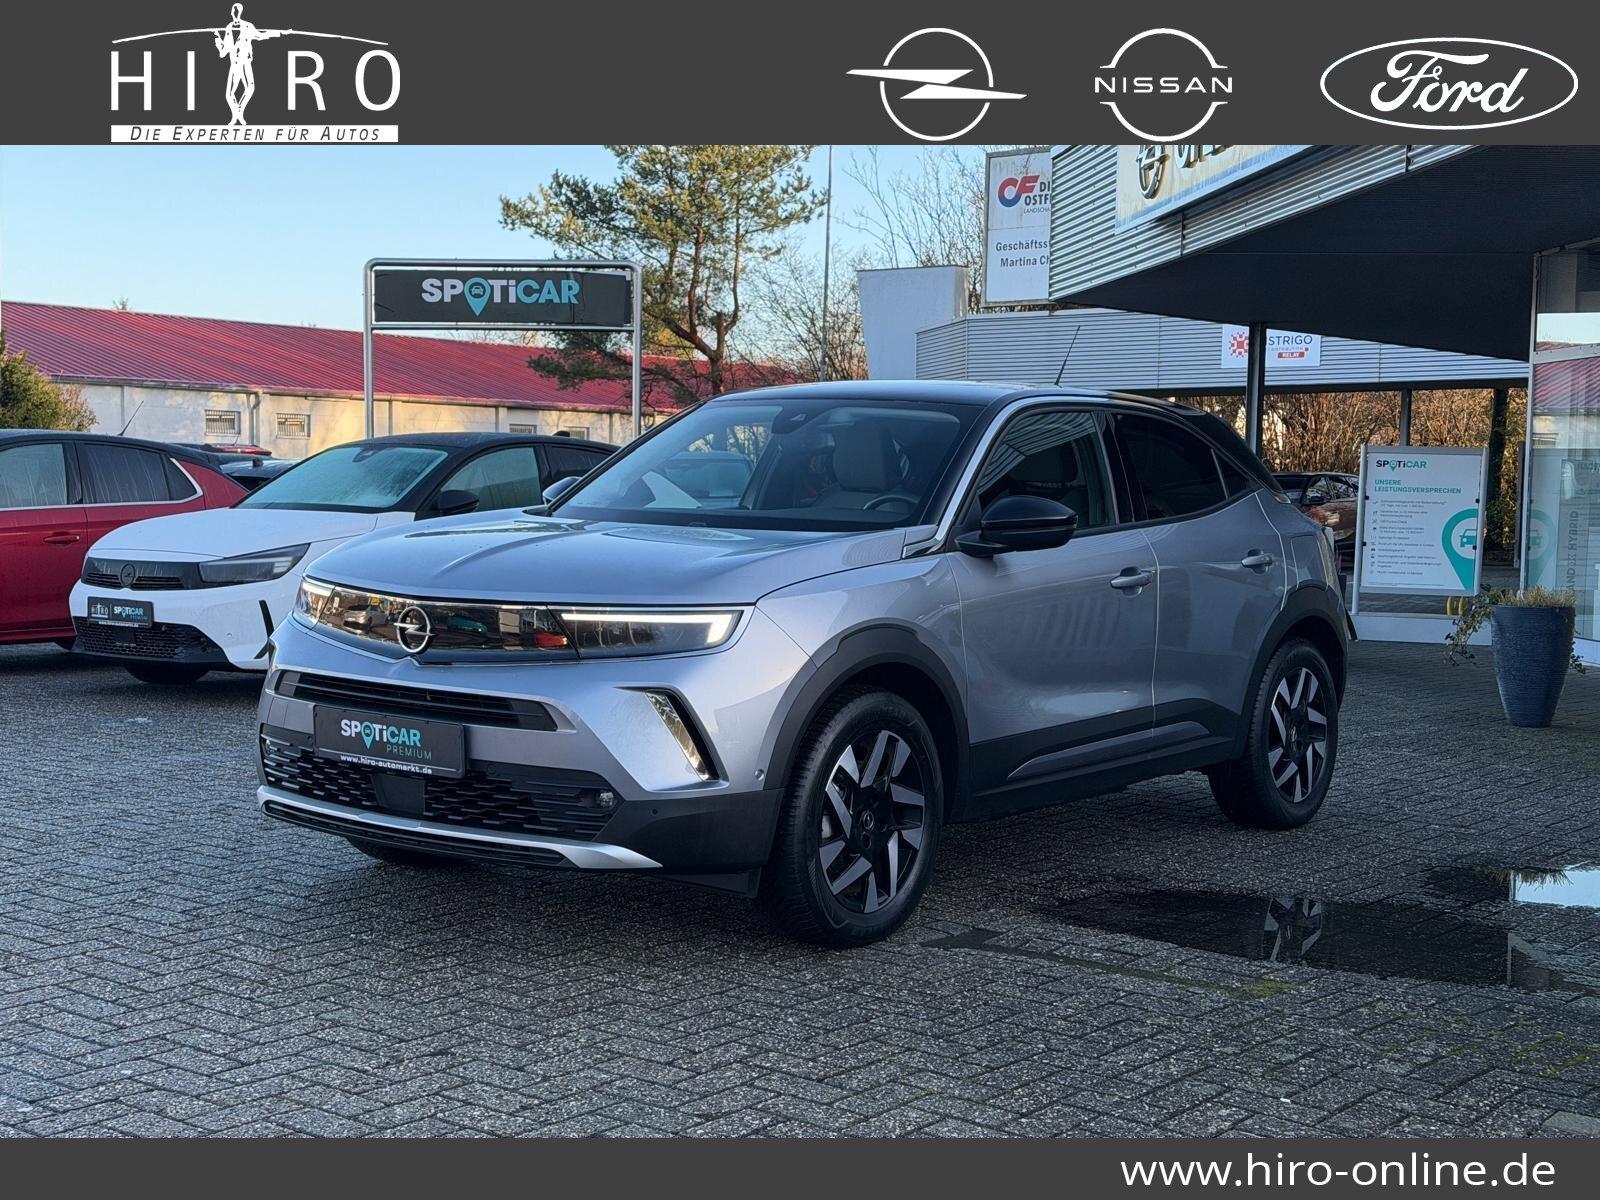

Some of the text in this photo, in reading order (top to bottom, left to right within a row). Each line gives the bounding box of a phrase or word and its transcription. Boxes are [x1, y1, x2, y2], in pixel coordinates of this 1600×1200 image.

[1039, 181, 1051, 192] DI
[1024, 193, 1051, 206] OSTF
[995, 239, 1051, 252] Geschäftss
[1000, 254, 1050, 268] Martina Ch
[1268, 334, 1313, 346] STRIGO
[1374, 486, 1462, 494] LEISTUNGSVERSPRECHEN
[386, 744, 432, 760] PREMIUM
[340, 754, 433, 775] www.hiro-automarkt.de
